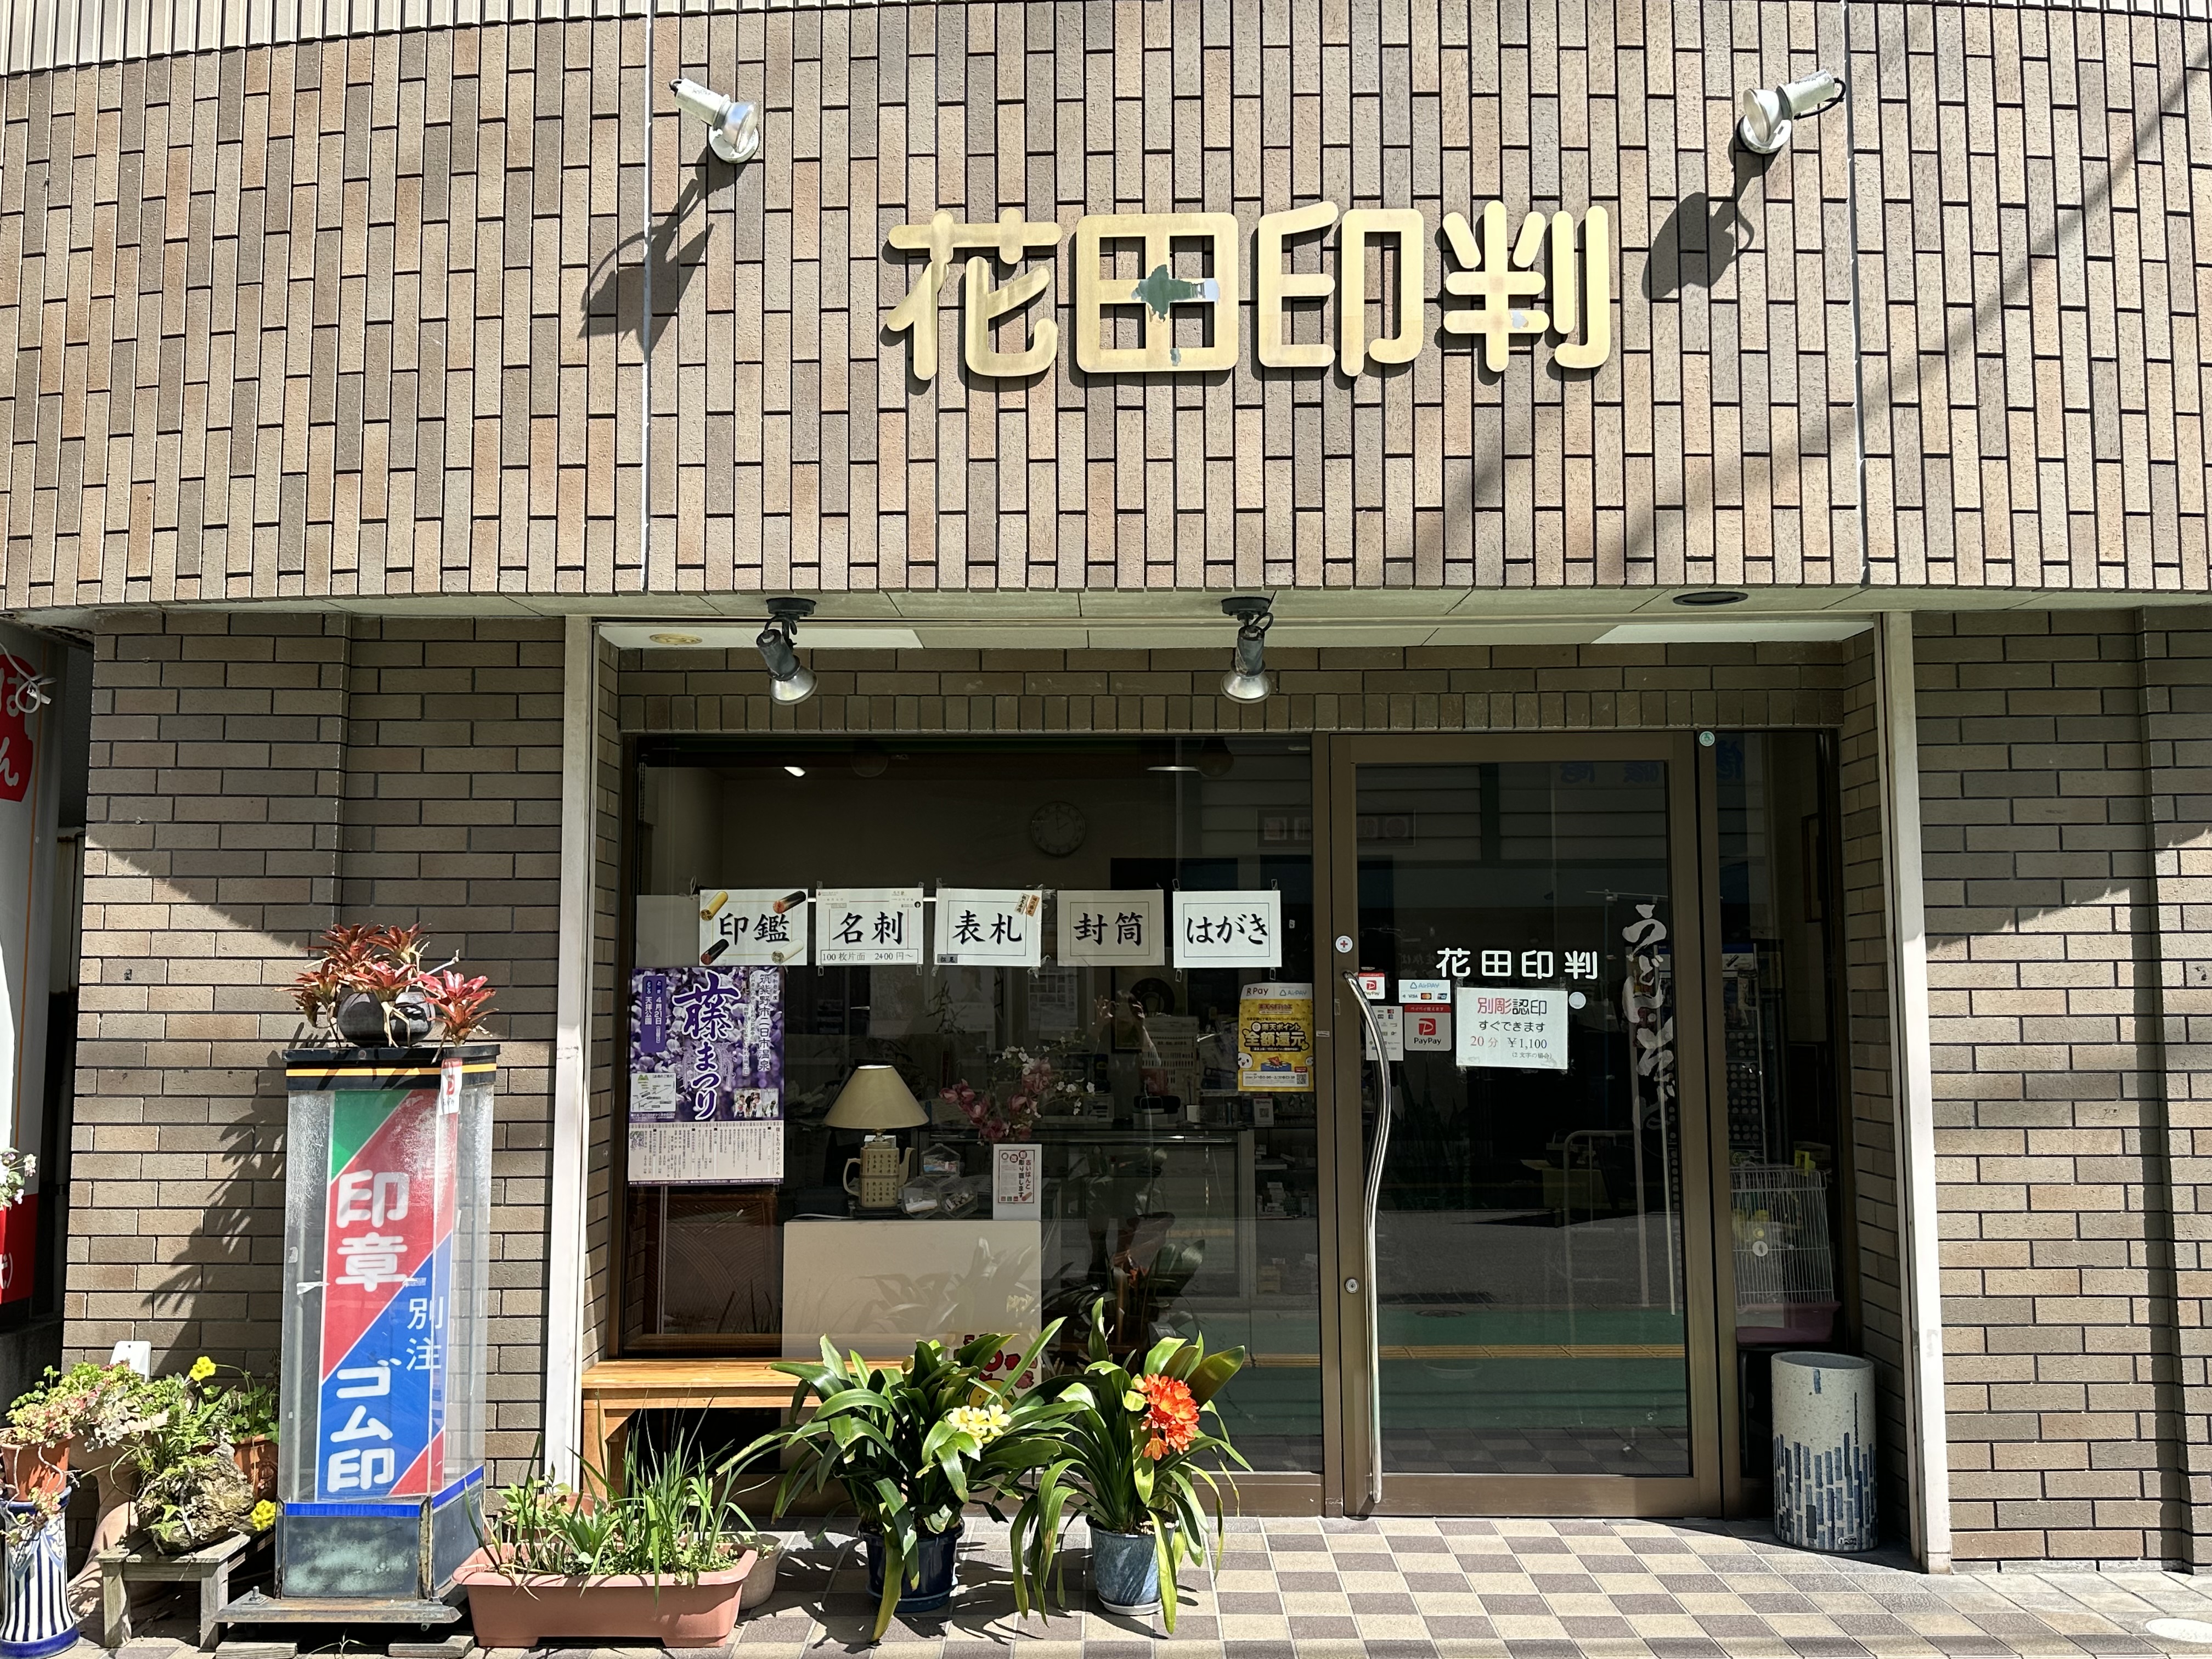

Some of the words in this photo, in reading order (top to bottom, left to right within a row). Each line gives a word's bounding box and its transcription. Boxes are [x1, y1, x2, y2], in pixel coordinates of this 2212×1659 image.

[886, 200, 1611, 380] 花田印判
[719, 913, 790, 945] 印鑑
[832, 911, 904, 945] 名刺
[951, 910, 1023, 945] 表札
[1073, 911, 1144, 947] 封筒
[1186, 913, 1268, 945] はがき
[1435, 947, 1598, 980] 花田印判
[1477, 997, 1548, 1016] 別彫認印
[1244, 1031, 1305, 1047] 全額還元
[1413, 1037, 1442, 1046] PayPay
[1479, 1019, 1546, 1033] すぐできます
[673, 969, 741, 1121] 藤まつり
[336, 1169, 409, 1293] 印章
[405, 1295, 443, 1372] 別注
[326, 1357, 403, 1492] ゴム印
